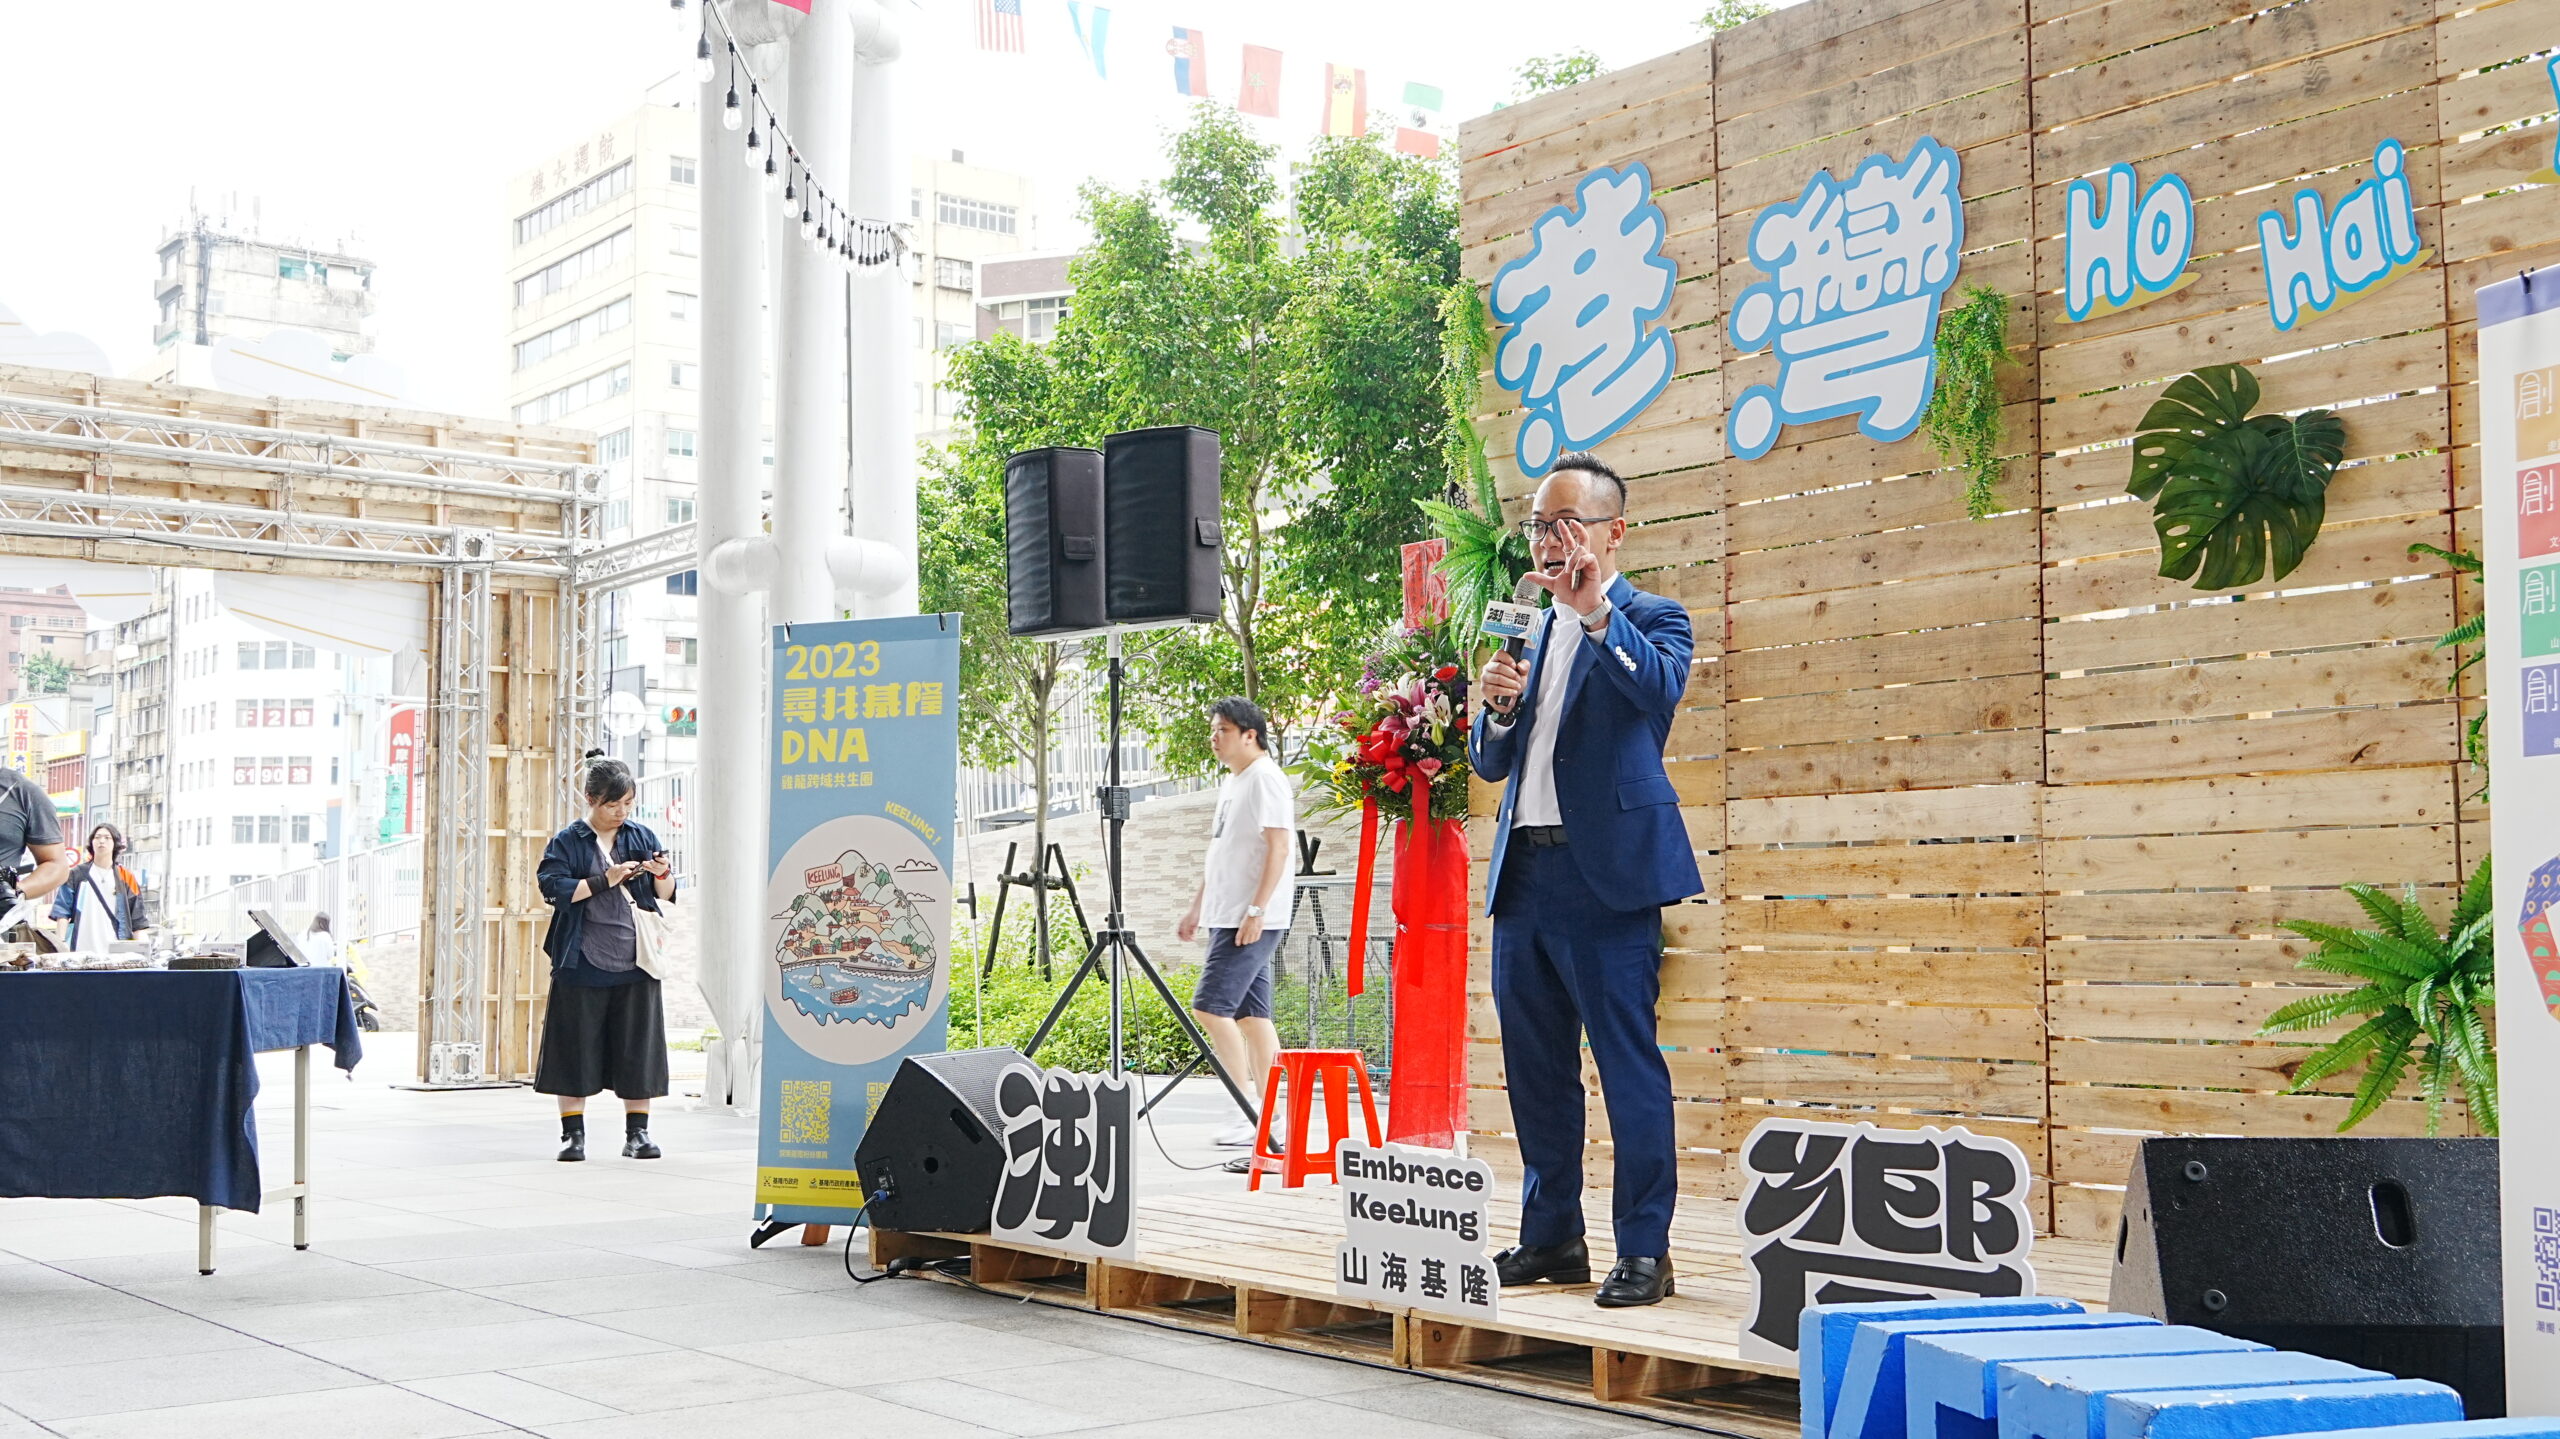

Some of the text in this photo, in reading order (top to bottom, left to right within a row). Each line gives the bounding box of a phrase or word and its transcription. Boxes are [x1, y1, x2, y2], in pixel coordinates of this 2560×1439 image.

[2066, 138, 2421, 331] Ho Hai
[2516, 369, 2554, 420] 創
[2519, 469, 2555, 516] 創
[2522, 570, 2557, 616] 創
[785, 640, 881, 680] 2023
[782, 681, 944, 724] 尋找基隆
[2525, 668, 2559, 715] 創
[781, 728, 870, 765] DNA
[807, 866, 841, 886] KEELUNG
[996, 1071, 1130, 1248] 潮
[1343, 1149, 1484, 1193] Embrace
[1350, 1191, 1480, 1241] Keelung
[1342, 1246, 1490, 1307] 山海基隆
